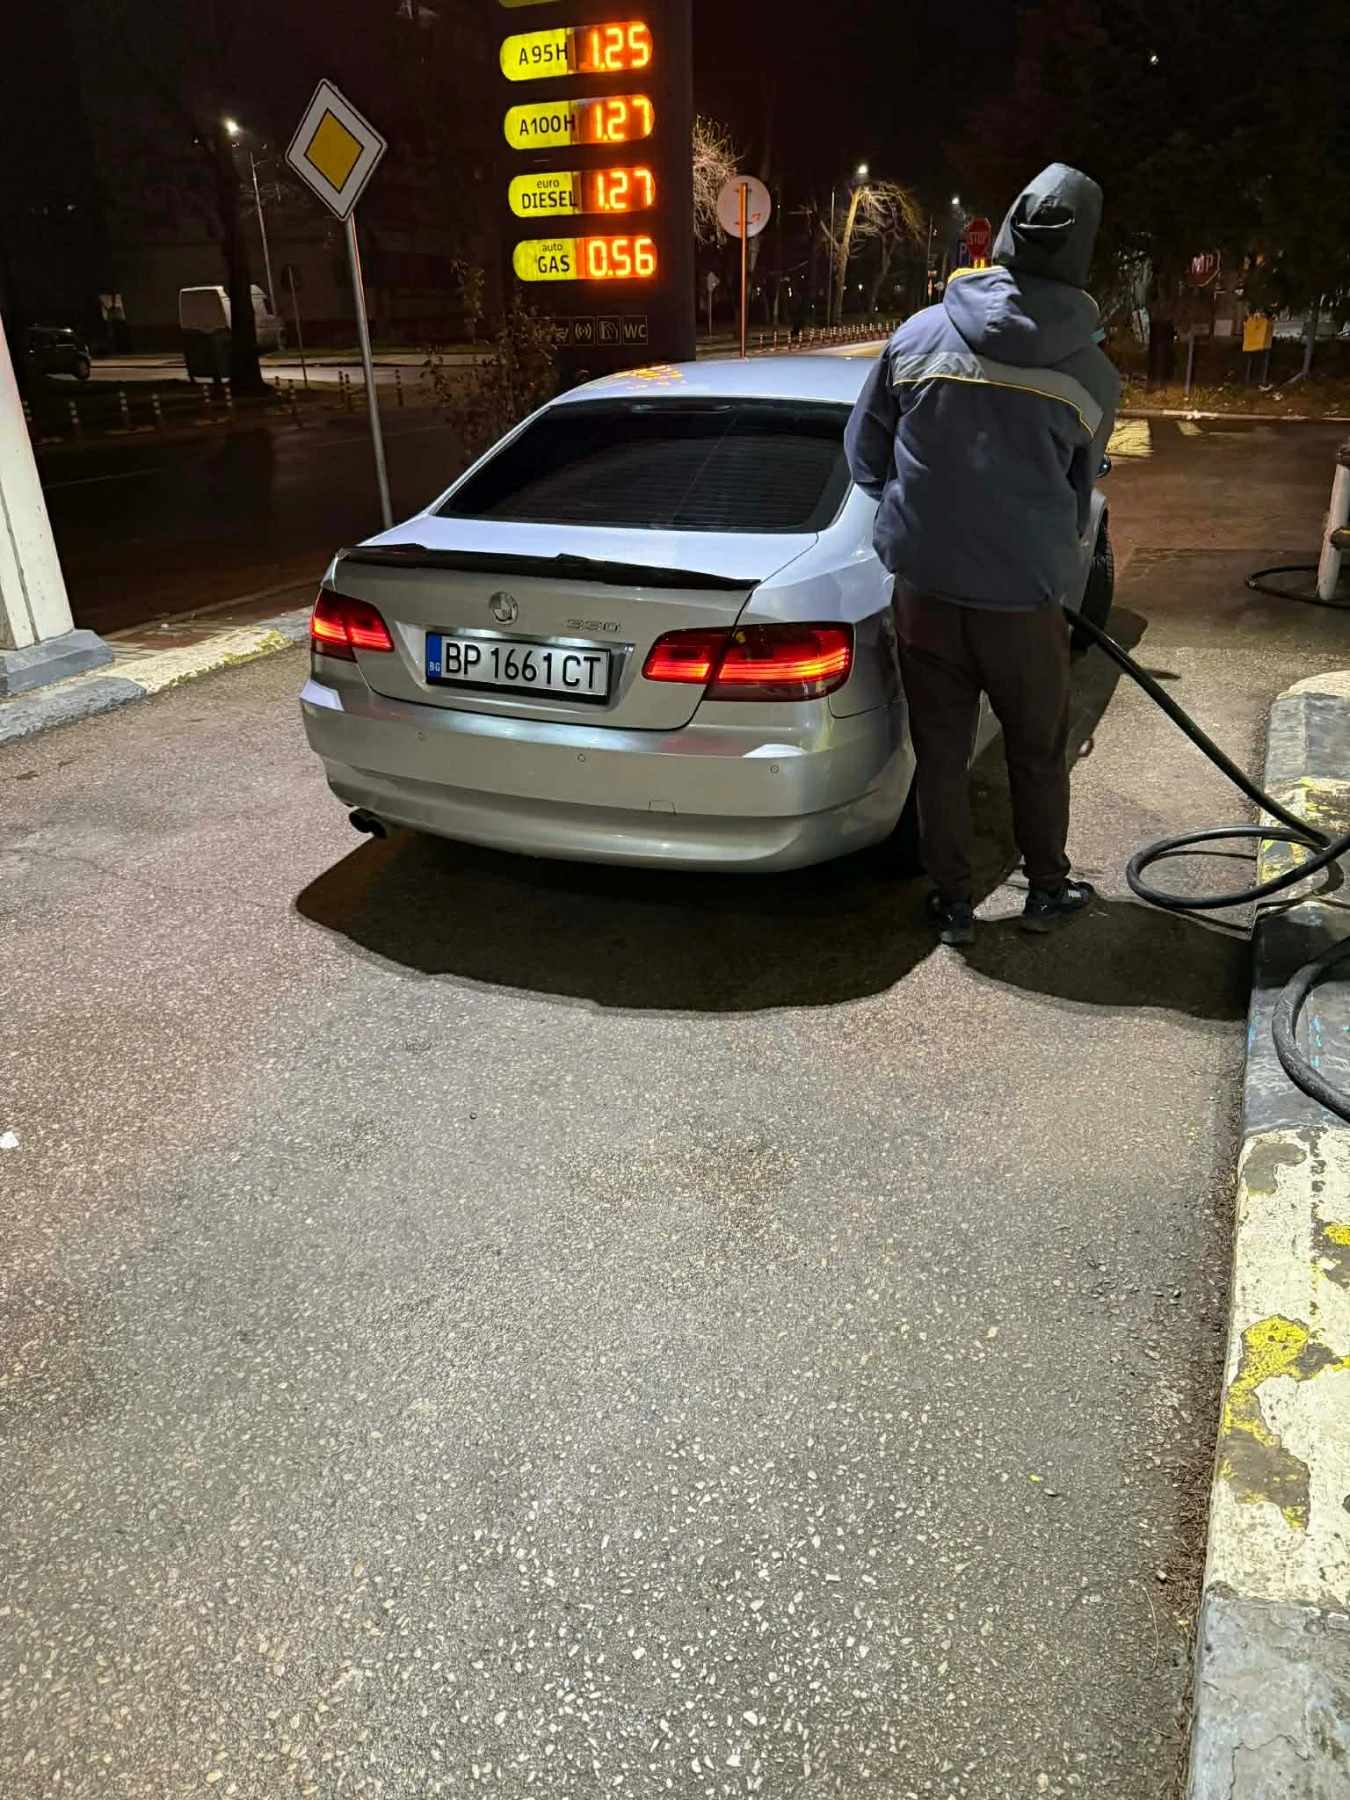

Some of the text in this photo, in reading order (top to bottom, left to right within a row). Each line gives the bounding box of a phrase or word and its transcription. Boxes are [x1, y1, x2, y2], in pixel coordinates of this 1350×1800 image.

[519, 42, 568, 66] A95H
[592, 24, 649, 69] 1.25
[519, 113, 576, 136] A100H
[595, 98, 651, 141] 1.27
[536, 179, 560, 189] euro
[597, 169, 653, 210] 1.27
[521, 190, 578, 210] DIESEL
[541, 243, 563, 252] auto
[588, 238, 655, 277] 0.56
[537, 255, 571, 274] GAS
[624, 323, 648, 339] WC
[429, 661, 441, 671] BG
[445, 642, 601, 690] BP 1661 CT
